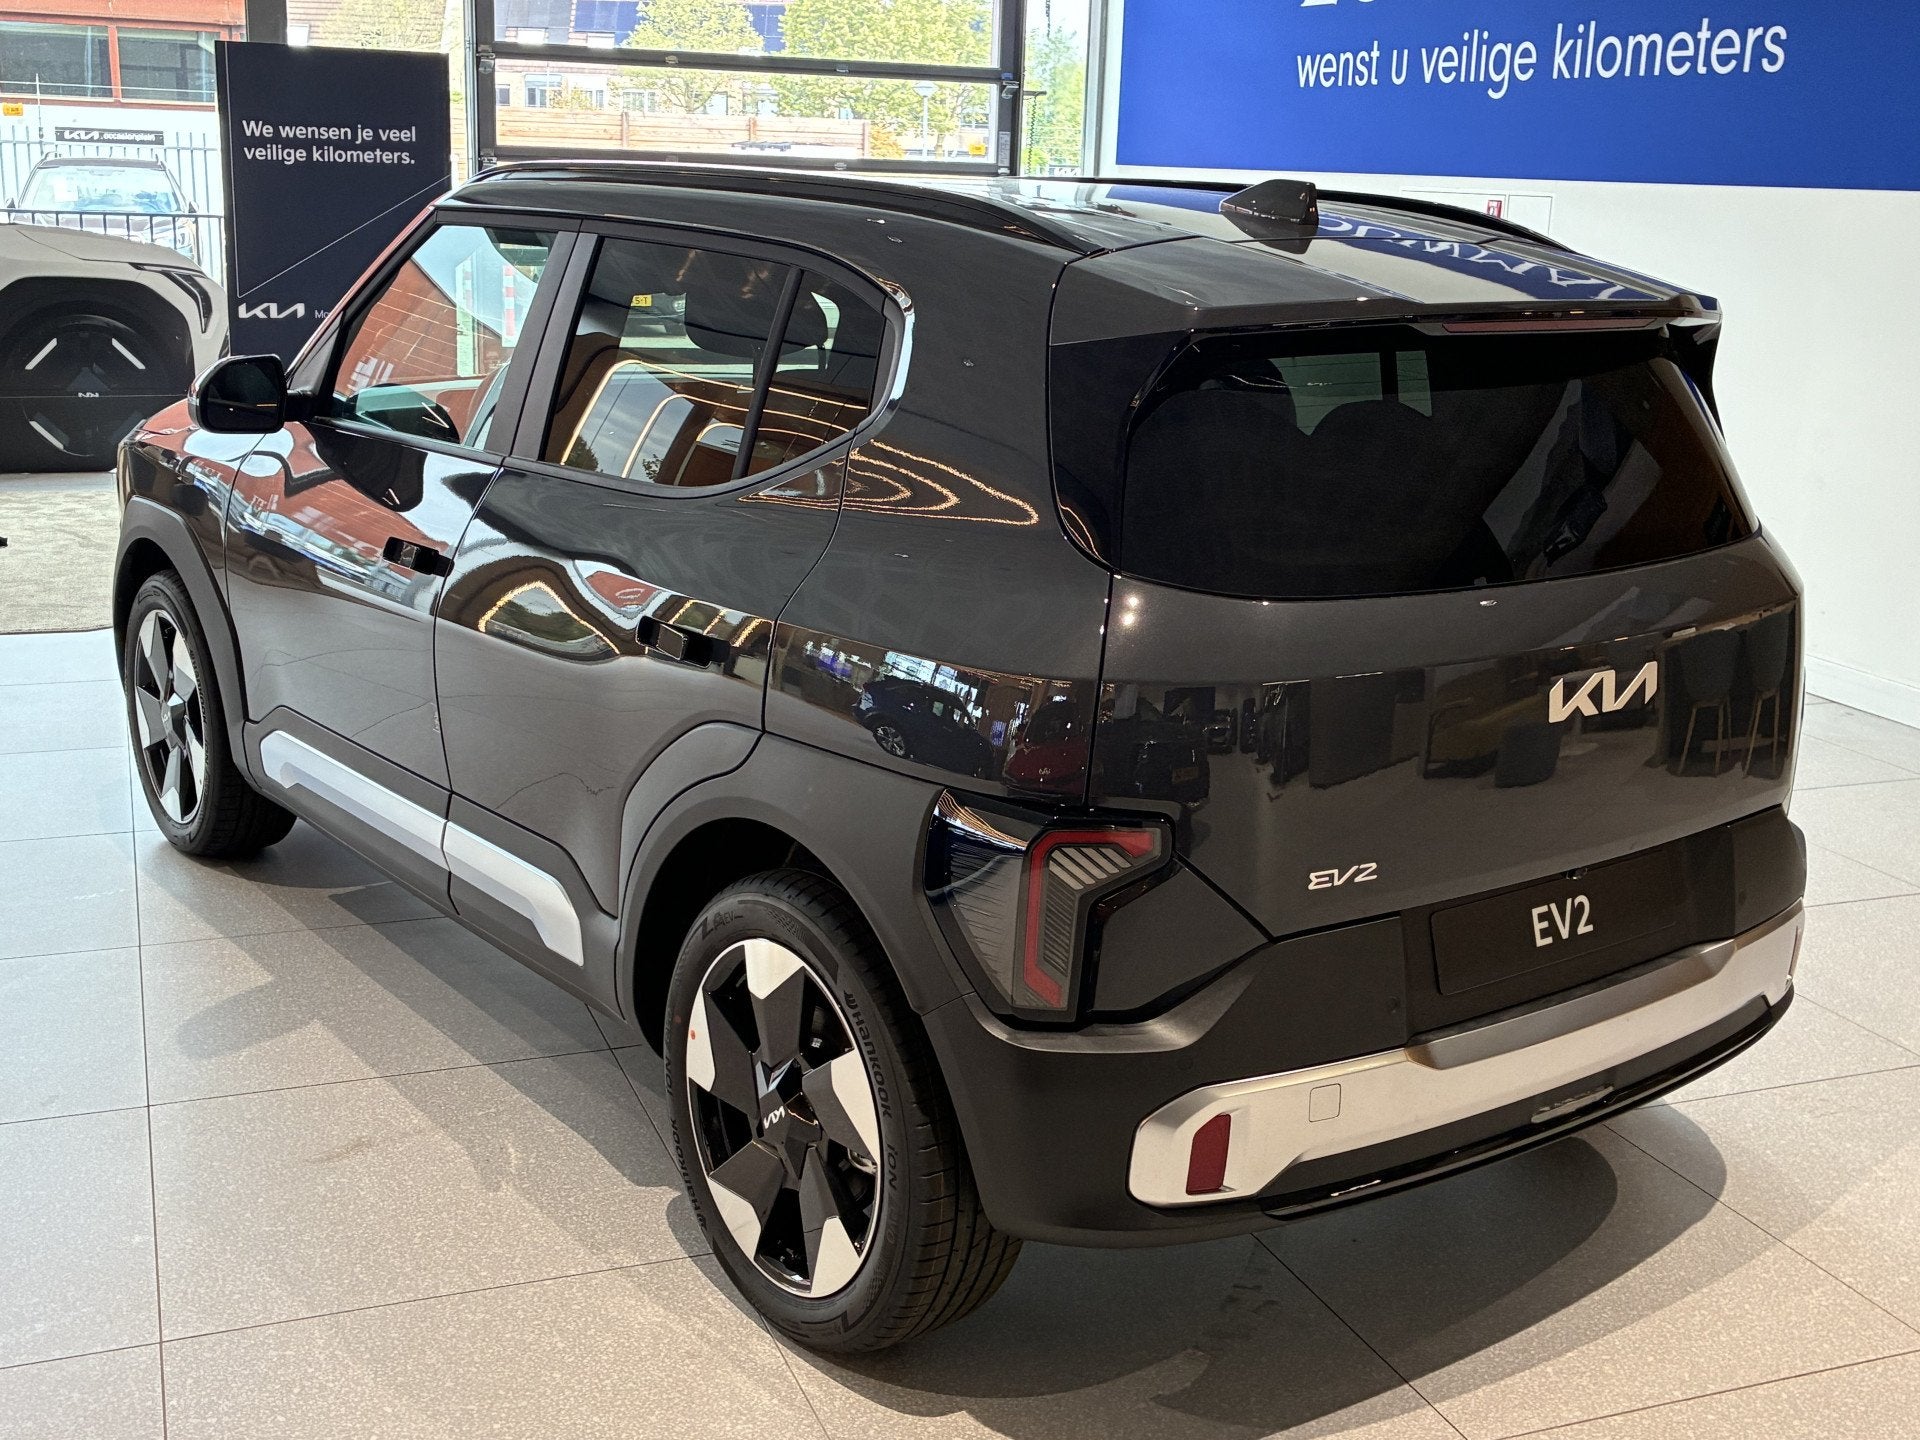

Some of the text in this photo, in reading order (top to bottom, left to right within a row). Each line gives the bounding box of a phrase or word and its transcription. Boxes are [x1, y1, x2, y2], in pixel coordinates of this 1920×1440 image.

[1297, 17, 1787, 99] wenst u veilige kilometers
[242, 119, 416, 144] We wensen je veel
[243, 143, 415, 165] veilige kilometers.
[238, 302, 305, 319] KIA
[1548, 660, 1658, 724] KIA
[1307, 862, 1378, 890] EV2
[1531, 894, 1594, 948] EV2
